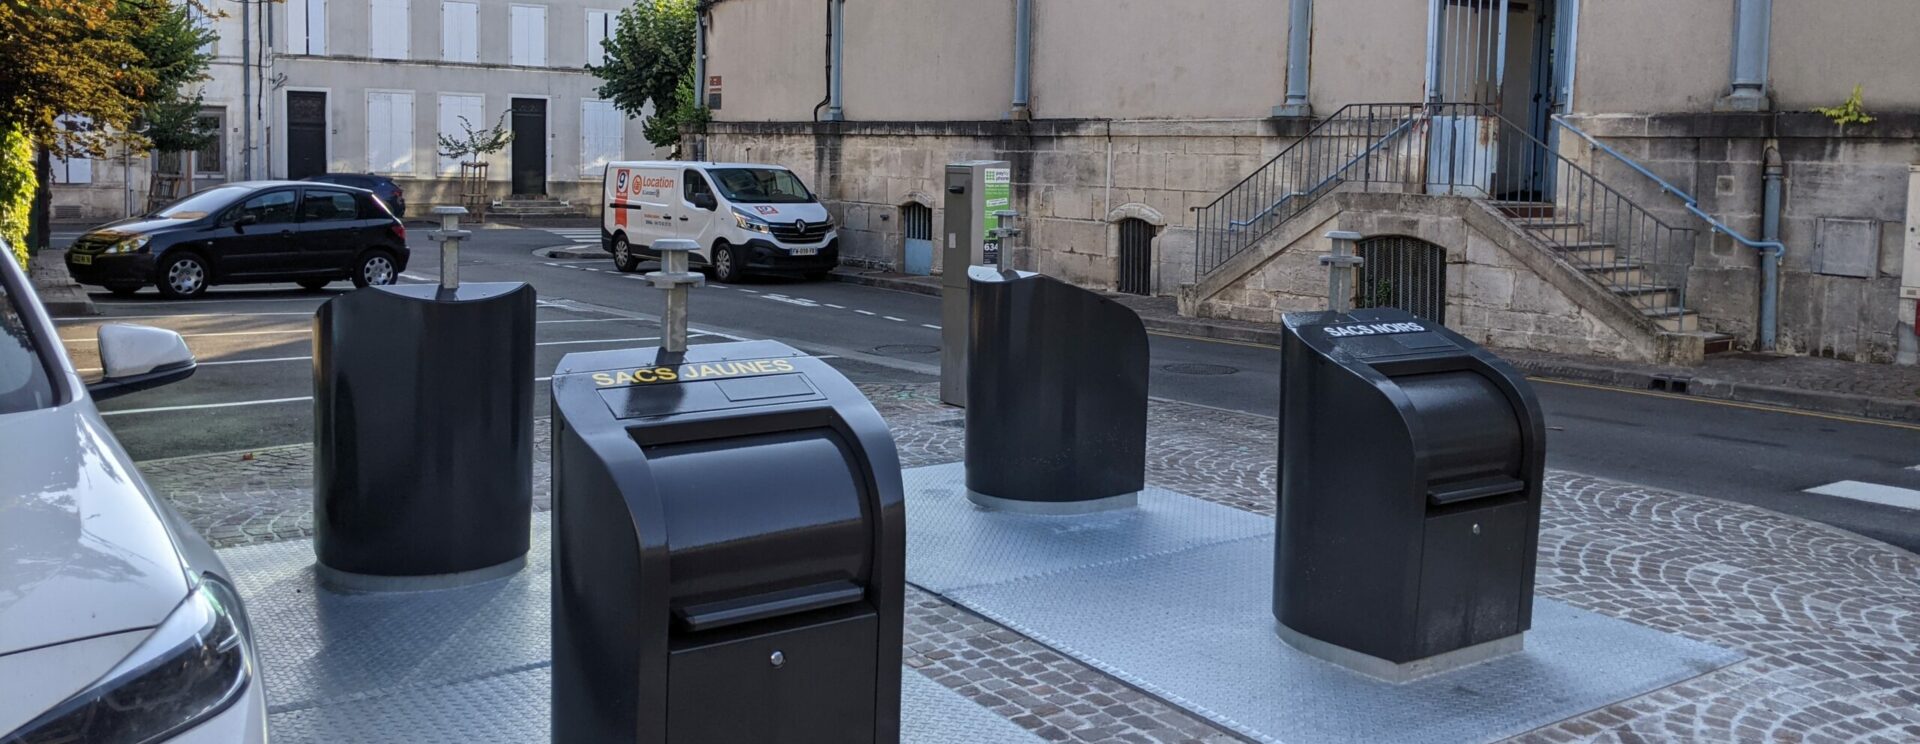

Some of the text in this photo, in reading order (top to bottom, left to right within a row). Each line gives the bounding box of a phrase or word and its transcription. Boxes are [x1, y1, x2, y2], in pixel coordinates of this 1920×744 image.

[618, 172, 626, 189] 9
[643, 176, 674, 188] Location
[1323, 322, 1425, 337] SACS NOIRS
[592, 359, 794, 386] SACS JAUNES
